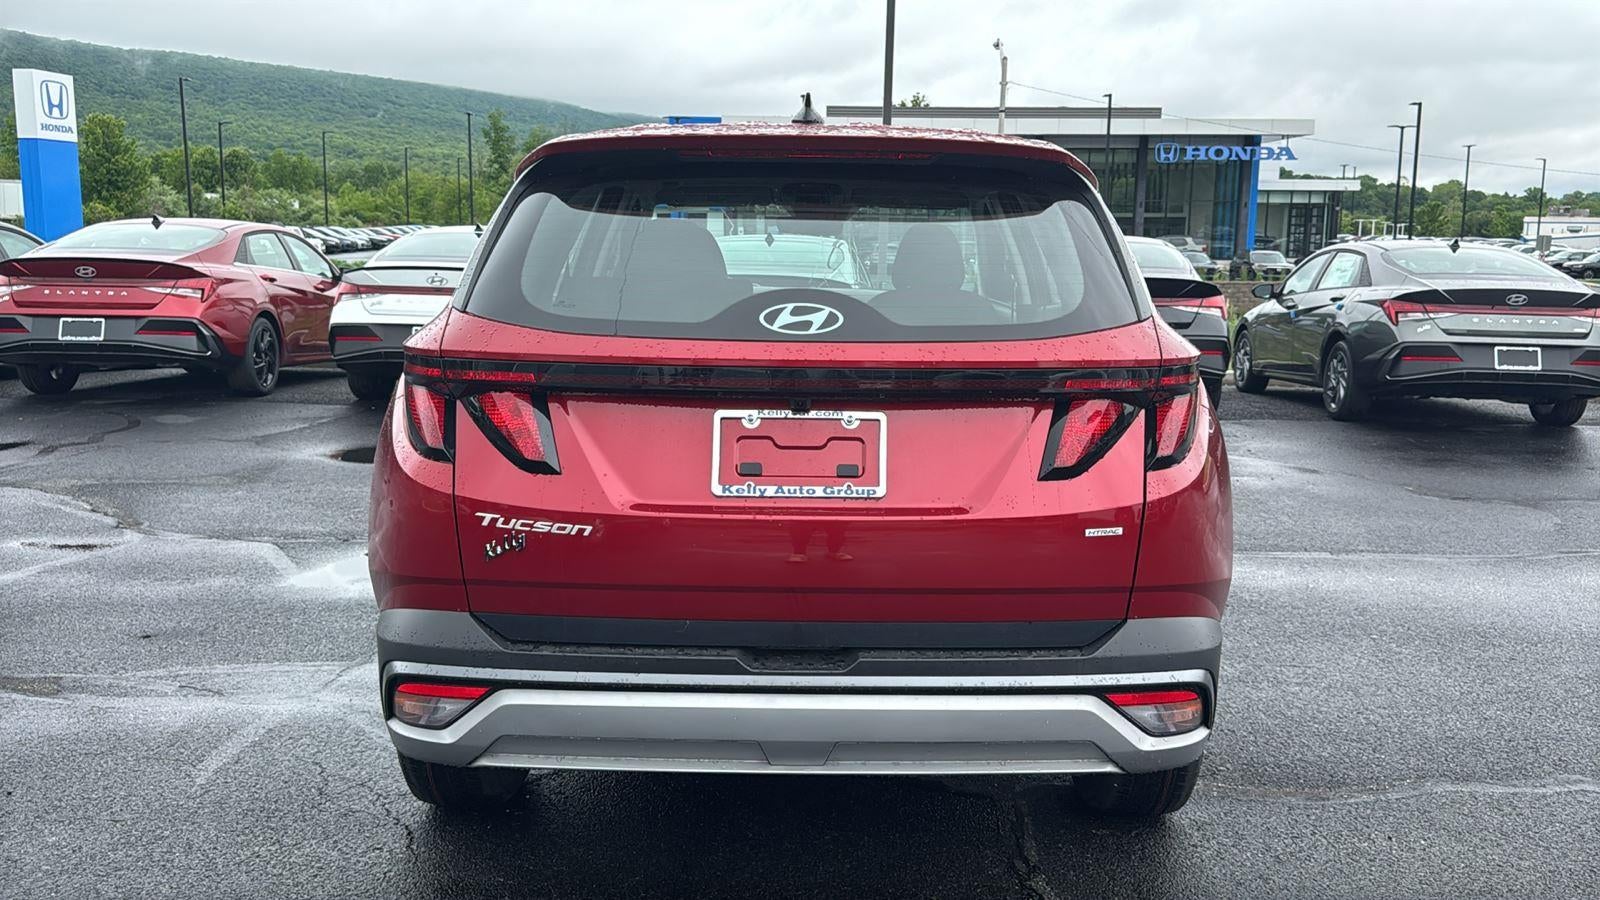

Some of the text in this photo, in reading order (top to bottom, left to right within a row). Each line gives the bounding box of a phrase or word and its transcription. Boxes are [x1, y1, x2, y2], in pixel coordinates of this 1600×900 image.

[40, 123, 74, 134] HONDA
[1183, 145, 1299, 161] HONDA
[721, 485, 877, 497] Kelly Auto Group
